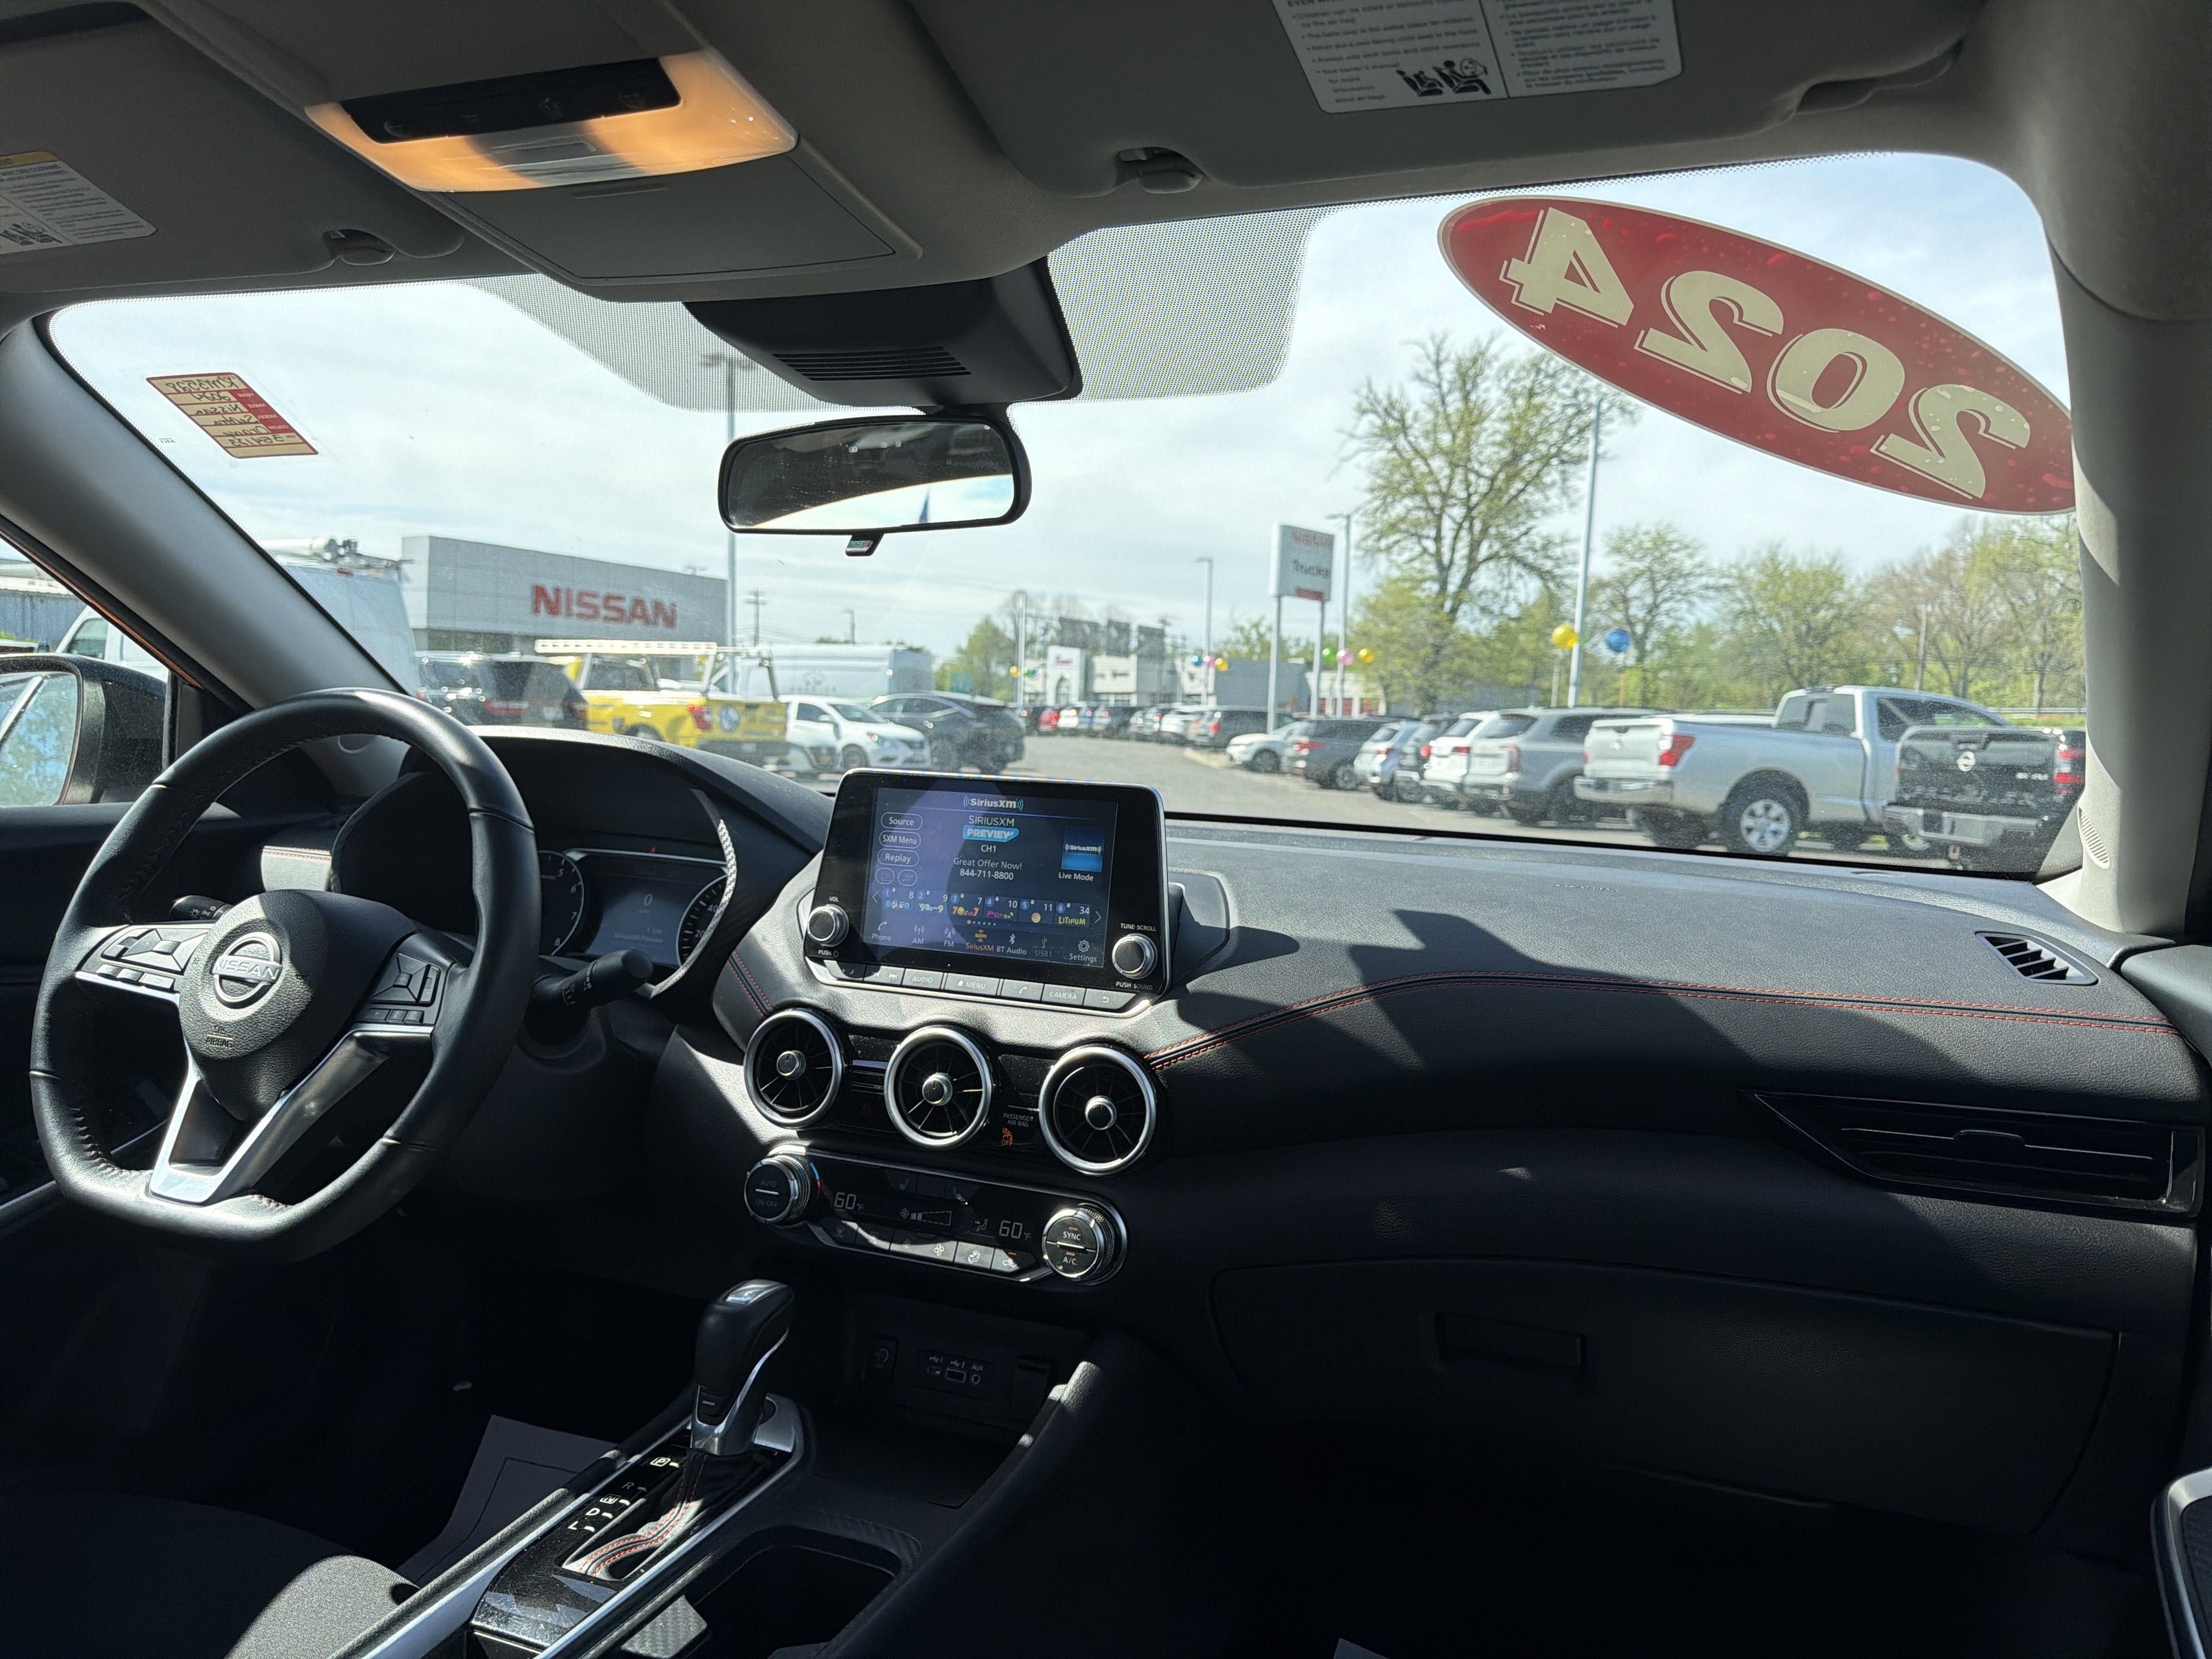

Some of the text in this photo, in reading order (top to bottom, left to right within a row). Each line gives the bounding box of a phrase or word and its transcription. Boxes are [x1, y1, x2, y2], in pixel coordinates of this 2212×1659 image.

[533, 584, 678, 629] NISSAN
[889, 816, 915, 826] Source
[968, 815, 1015, 827] SIRIUSXM
[967, 828, 1015, 839] PREVIEW
[882, 834, 917, 845] SXM Menu
[980, 845, 997, 854] CH1
[885, 853, 912, 865] Replay
[953, 857, 1023, 870] Great Offer Now!
[960, 868, 1014, 881] 844-711-8800
[1074, 873, 1094, 881] Mode
[571, 885, 577, 894] 6
[644, 893, 653, 906] 0
[909, 891, 914, 899] 8
[978, 897, 983, 905] 7
[1008, 900, 1018, 909] 10
[1043, 903, 1053, 911] 11
[1079, 906, 1090, 915] 34
[872, 933, 892, 941] Phone
[555, 938, 561, 947] 8
[966, 942, 994, 951] SiriusXM
[1006, 947, 1027, 955] Audio
[1069, 953, 1097, 963] Settings
[217, 960, 280, 980] NISSAN
[966, 981, 986, 990] MENU
[1049, 991, 1077, 1000] CAMERA
[1003, 1113, 1034, 1122] PASSENGER
[760, 1180, 777, 1188] AUTO
[1063, 1231, 1081, 1242] SYNC
[1063, 1256, 1077, 1266] A/C
[620, 1481, 635, 1490] R
[585, 1508, 601, 1516] D
[567, 1520, 579, 1530] L
